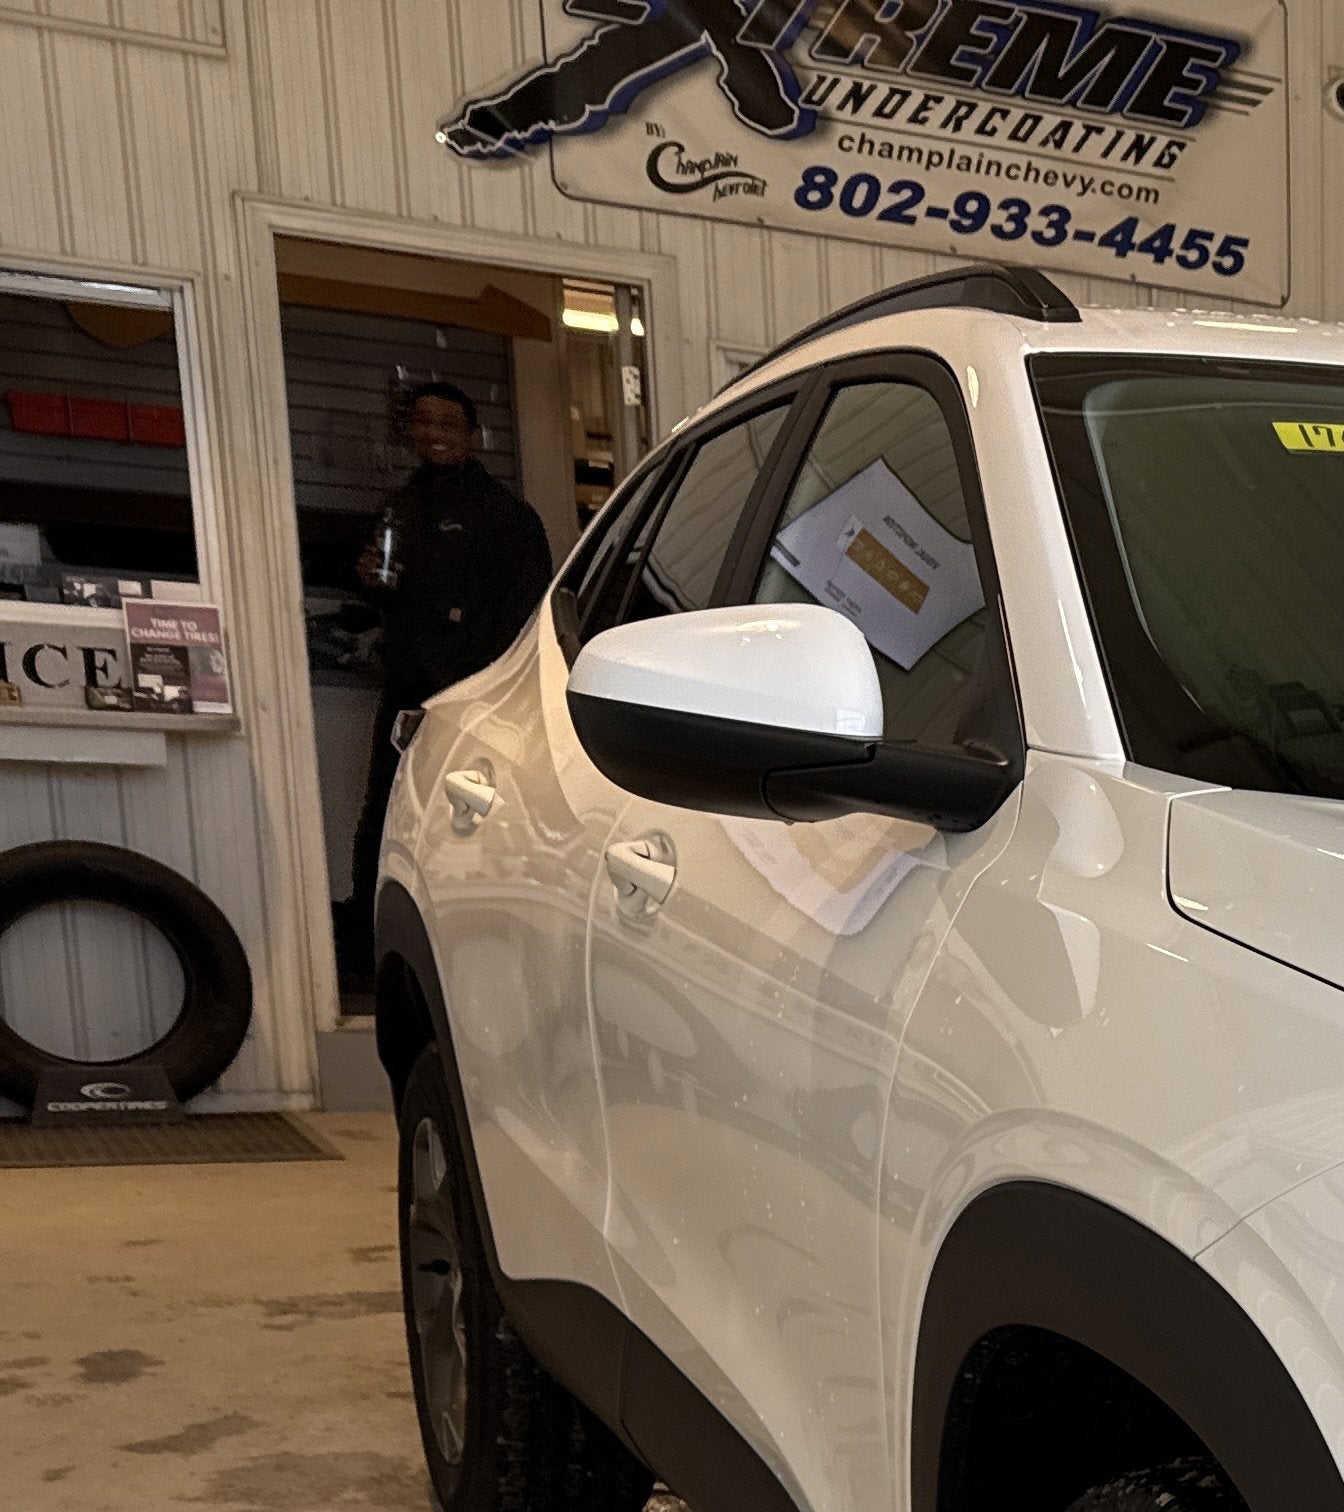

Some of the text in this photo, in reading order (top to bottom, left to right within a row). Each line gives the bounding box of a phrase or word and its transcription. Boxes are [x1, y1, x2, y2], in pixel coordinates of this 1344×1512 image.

[800, 74, 1187, 170] UNDERCOATING
[838, 132, 1161, 205] champlainchevy.com
[793, 166, 1250, 278] 802-933-4455
[131, 627, 181, 641] CHANGE
[150, 617, 198, 632] TIME TO
